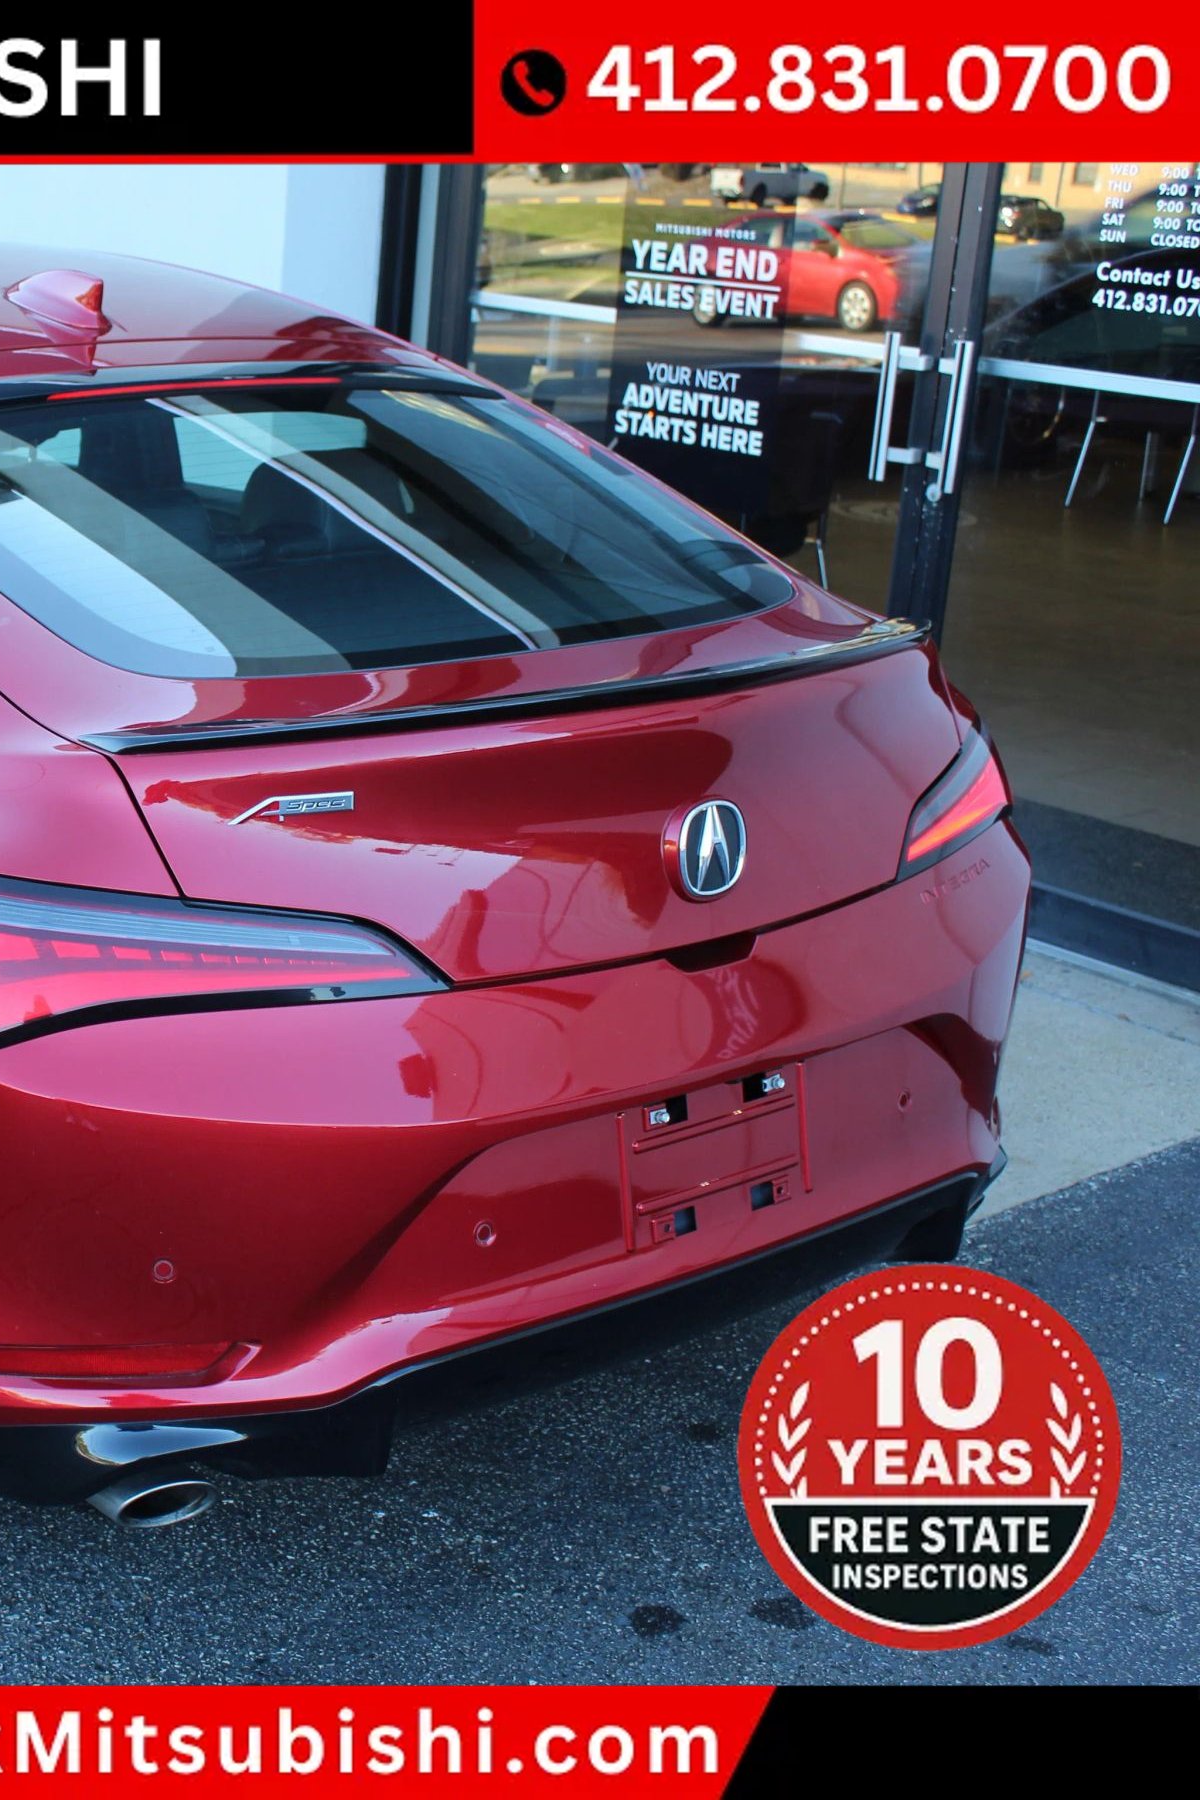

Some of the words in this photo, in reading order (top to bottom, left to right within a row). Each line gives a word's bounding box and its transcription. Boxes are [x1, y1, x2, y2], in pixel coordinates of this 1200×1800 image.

[1110, 163, 1139, 177] WED
[1161, 166, 1189, 180] 9:00
[1108, 180, 1132, 193] THU
[1158, 183, 1188, 197] 9:00
[1104, 197, 1124, 209] FRI
[1156, 199, 1184, 213] 9:00
[655, 222, 712, 237] MITSUBISHI
[714, 227, 756, 241] MOTORS
[1102, 213, 1126, 226] SAT
[1153, 216, 1181, 230] 9:00
[1099, 229, 1126, 243] SUN
[1150, 232, 1200, 249] CLOSED
[632, 239, 709, 276] YEAR
[715, 247, 779, 282] END
[1096, 261, 1171, 287] Contact
[624, 279, 695, 311] SALES
[699, 288, 779, 319] EVENT
[1092, 288, 1200, 318] 412.831.07
[646, 361, 692, 387] YOUR
[694, 368, 741, 393] NEXT
[622, 382, 760, 426] ADVENTURE
[614, 409, 697, 446] STARTS
[700, 424, 764, 456] HERE
